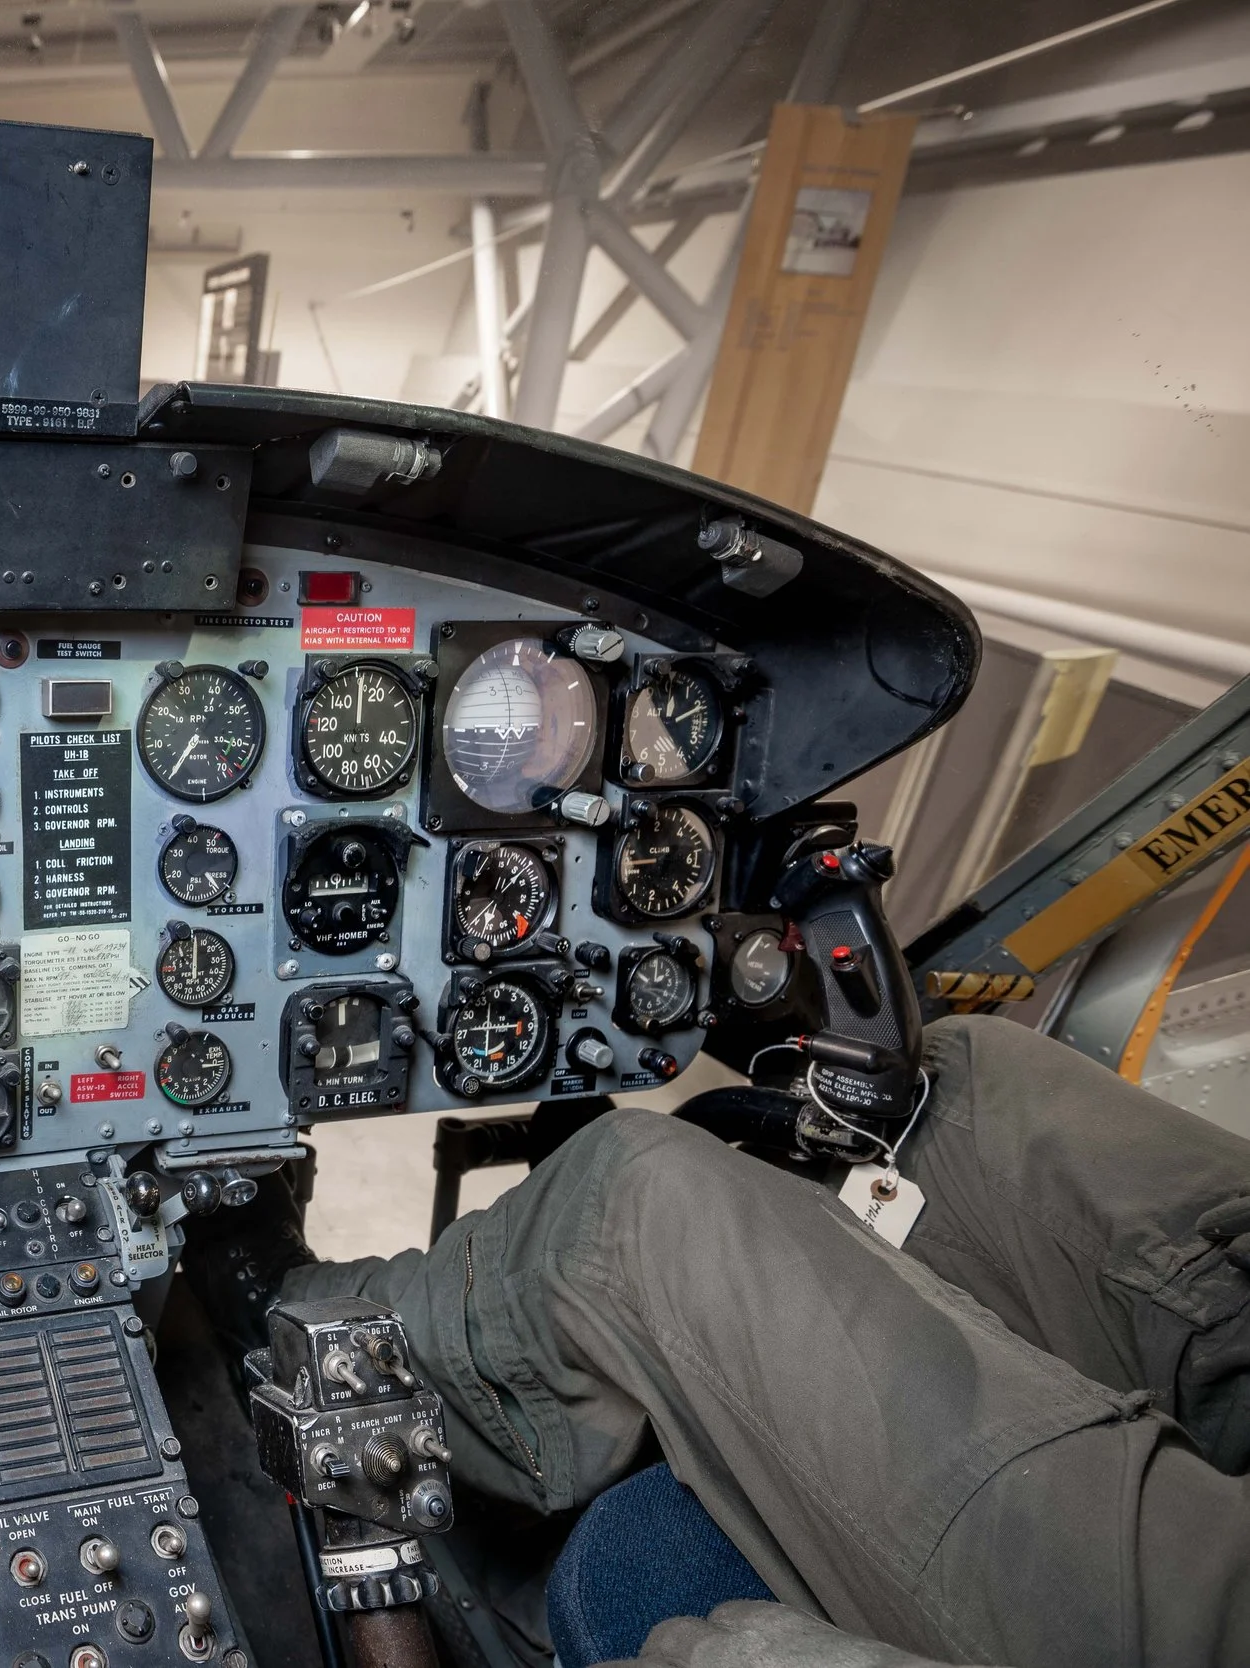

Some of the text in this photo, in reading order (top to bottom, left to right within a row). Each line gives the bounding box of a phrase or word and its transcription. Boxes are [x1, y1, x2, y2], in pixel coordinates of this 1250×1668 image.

[221, 618, 267, 626] DETECTOR
[336, 613, 382, 623] CAUTION
[383, 636, 409, 644] TANKS.
[30, 734, 121, 745] PILOTS CHECK LIST
[64, 750, 89, 760] UH-1B
[53, 768, 99, 779] TAKE OFF
[44, 788, 104, 800] INSTRUMENTS
[45, 804, 89, 815] CONTROLS
[33, 818, 117, 831] 3. GOVERNOR RPM.
[59, 837, 95, 848] LANDING
[214, 905, 257, 914] TORQUE
[204, 1011, 254, 1021] PRODUCER
[199, 1104, 244, 1114] EXHAUST
[68, 1230, 83, 1238] OFF
[136, 1243, 156, 1252] HEAT
[127, 1250, 164, 1261] SELECTOR
[73, 1296, 104, 1306] ENGINE
[11, 1305, 37, 1316] ROTOR
[378, 1385, 391, 1393] OFF
[331, 1390, 352, 1400] STOW
[351, 1415, 402, 1430] SEARCH CONT
[311, 1428, 331, 1438] INCR
[418, 1462, 437, 1472] RETR
[318, 1481, 336, 1491] DECR
[107, 1495, 135, 1509] FUEL
[143, 1492, 171, 1505] START
[74, 1505, 101, 1518] MAIN
[13, 1511, 50, 1526] VALVE
[8, 1528, 36, 1541] OPEN
[168, 1566, 186, 1578] OFF
[328, 1565, 364, 1574] INCREASE
[94, 1581, 113, 1593] OFF
[168, 1583, 197, 1598] GOV
[19, 1594, 51, 1608] CLOSE
[59, 1589, 88, 1604] FUEL
[35, 1600, 117, 1626] TRANS PUMP
